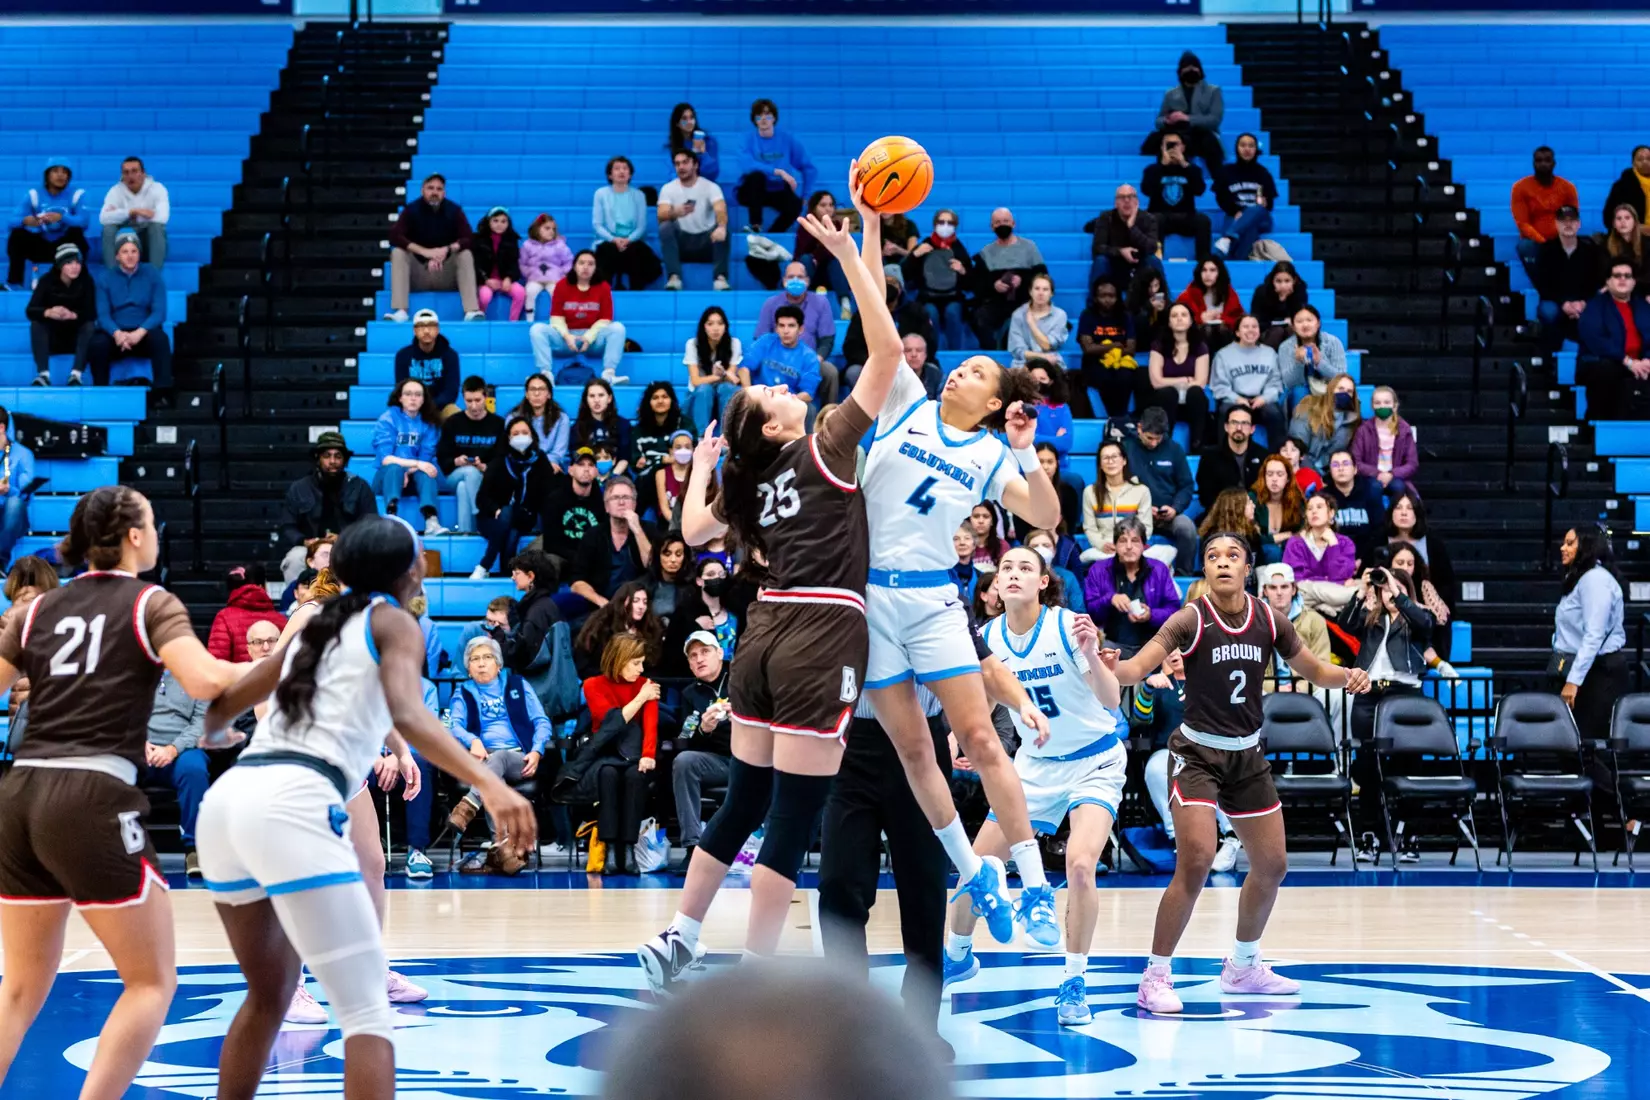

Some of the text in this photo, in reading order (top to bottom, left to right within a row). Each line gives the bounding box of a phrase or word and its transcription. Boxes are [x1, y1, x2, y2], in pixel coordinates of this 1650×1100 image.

[898, 441, 975, 491] COLUMBIA
[756, 467, 801, 528] 25
[904, 475, 940, 516] 4
[889, 573, 899, 587] C
[49, 613, 107, 676] 21
[1212, 643, 1262, 665] BROWN
[840, 666, 858, 703] B
[1016, 663, 1064, 682] UMBIA
[1229, 669, 1247, 704] 2
[510, 689, 520, 699] C
[118, 811, 146, 855] B
